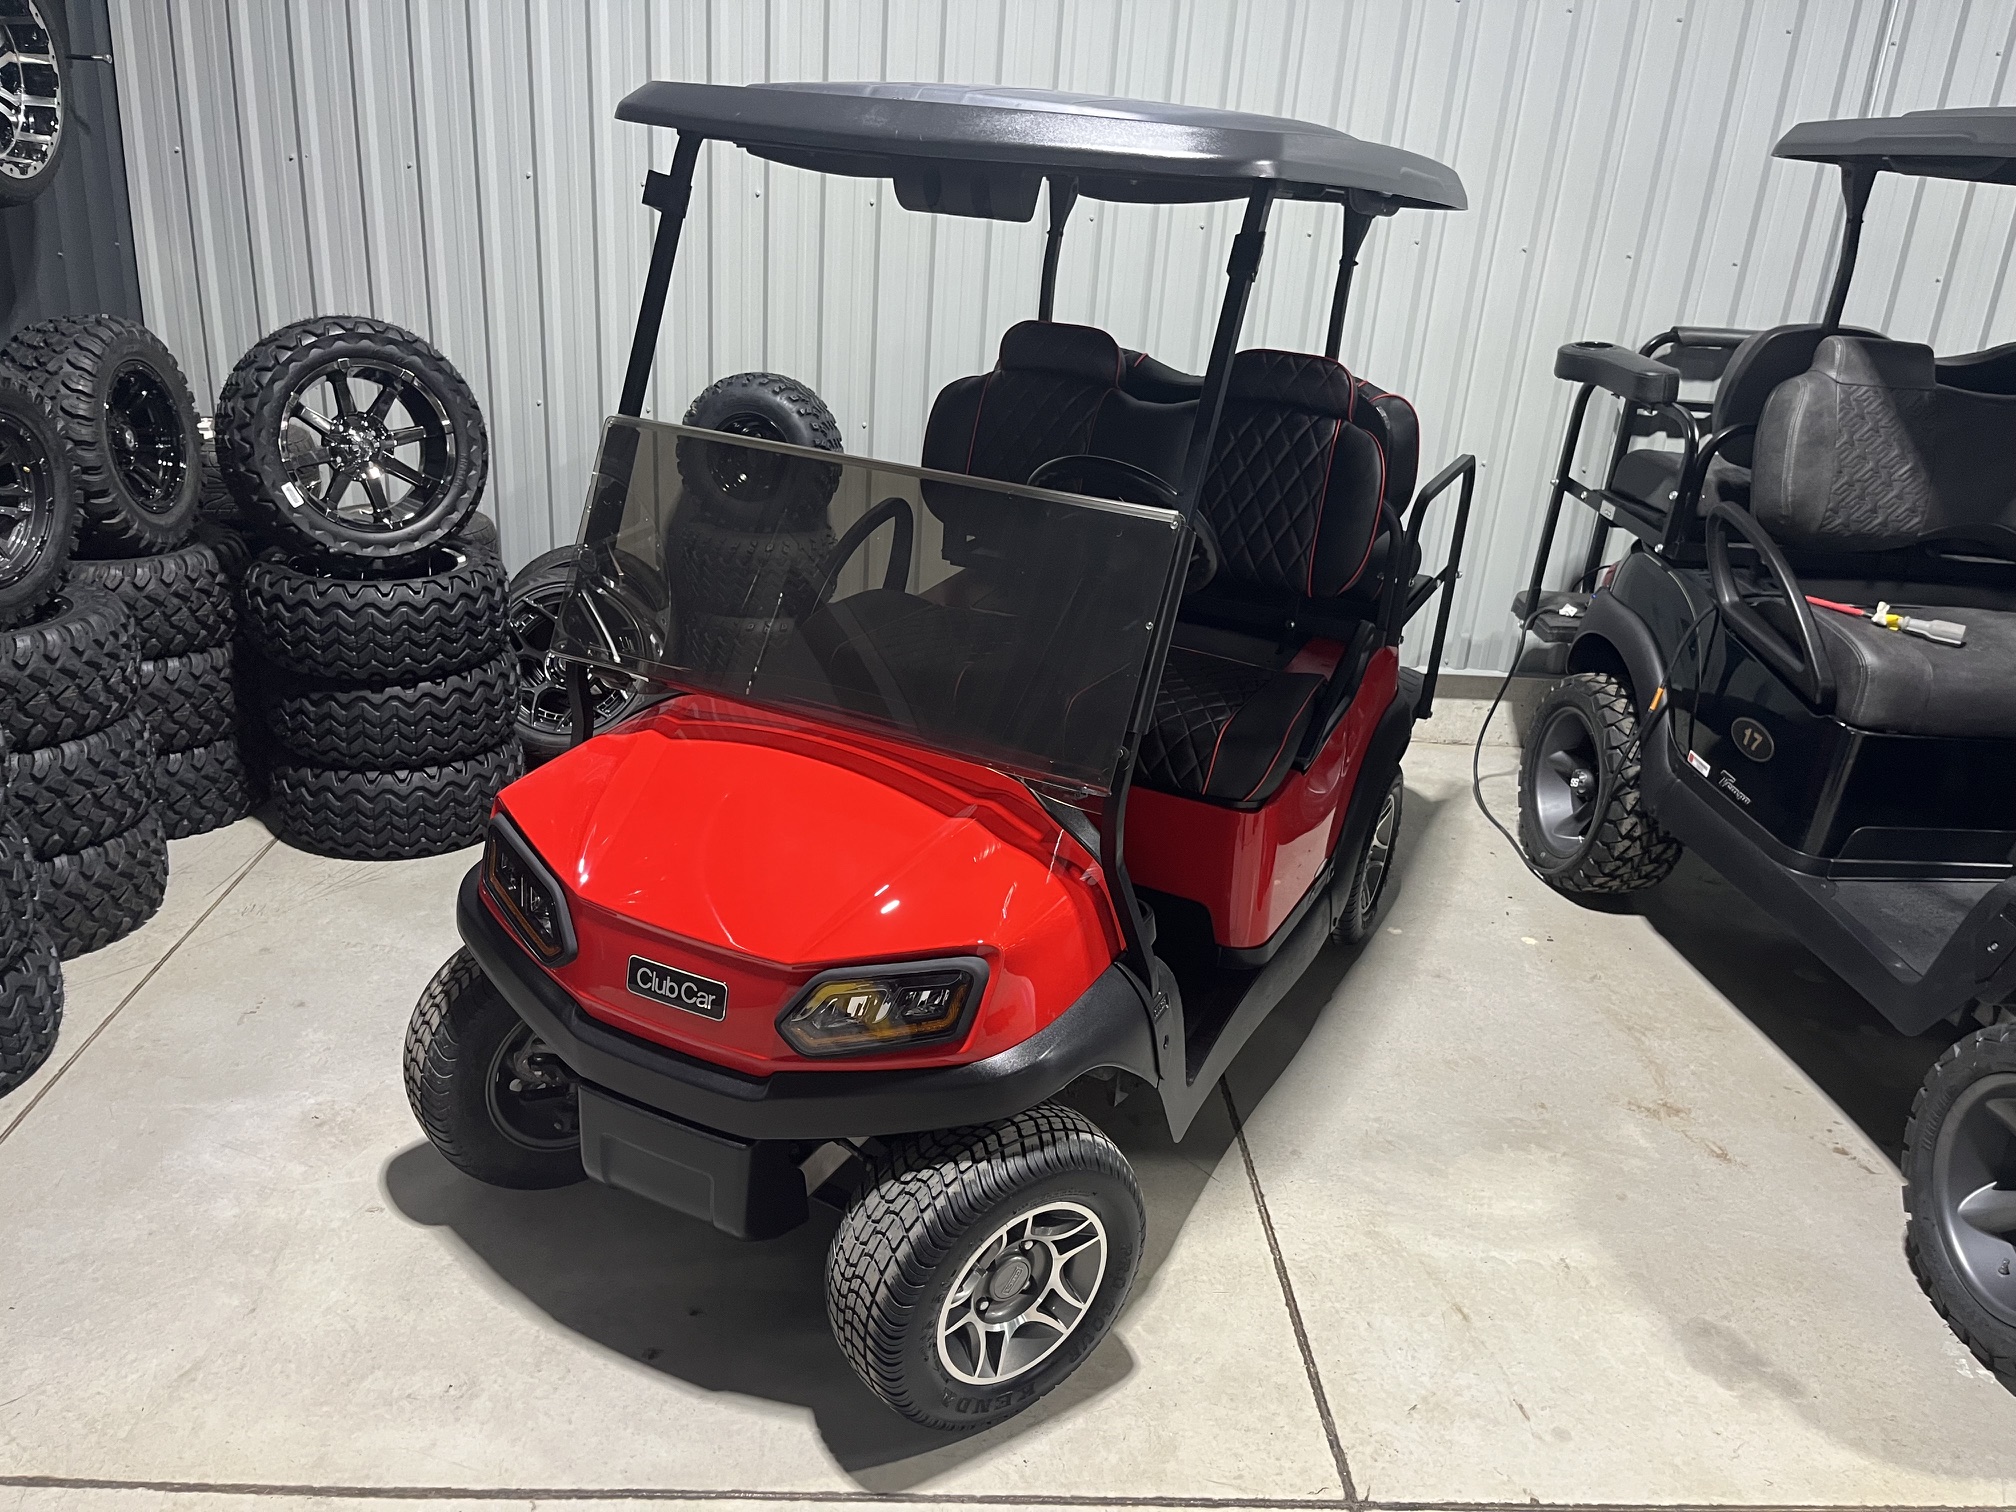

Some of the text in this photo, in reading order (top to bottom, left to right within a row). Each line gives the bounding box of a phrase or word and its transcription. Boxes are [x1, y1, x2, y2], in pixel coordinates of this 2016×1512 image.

[1742, 727, 1763, 751] 17
[636, 967, 716, 1010] Club Car
[940, 1381, 1036, 1415] KENDA
